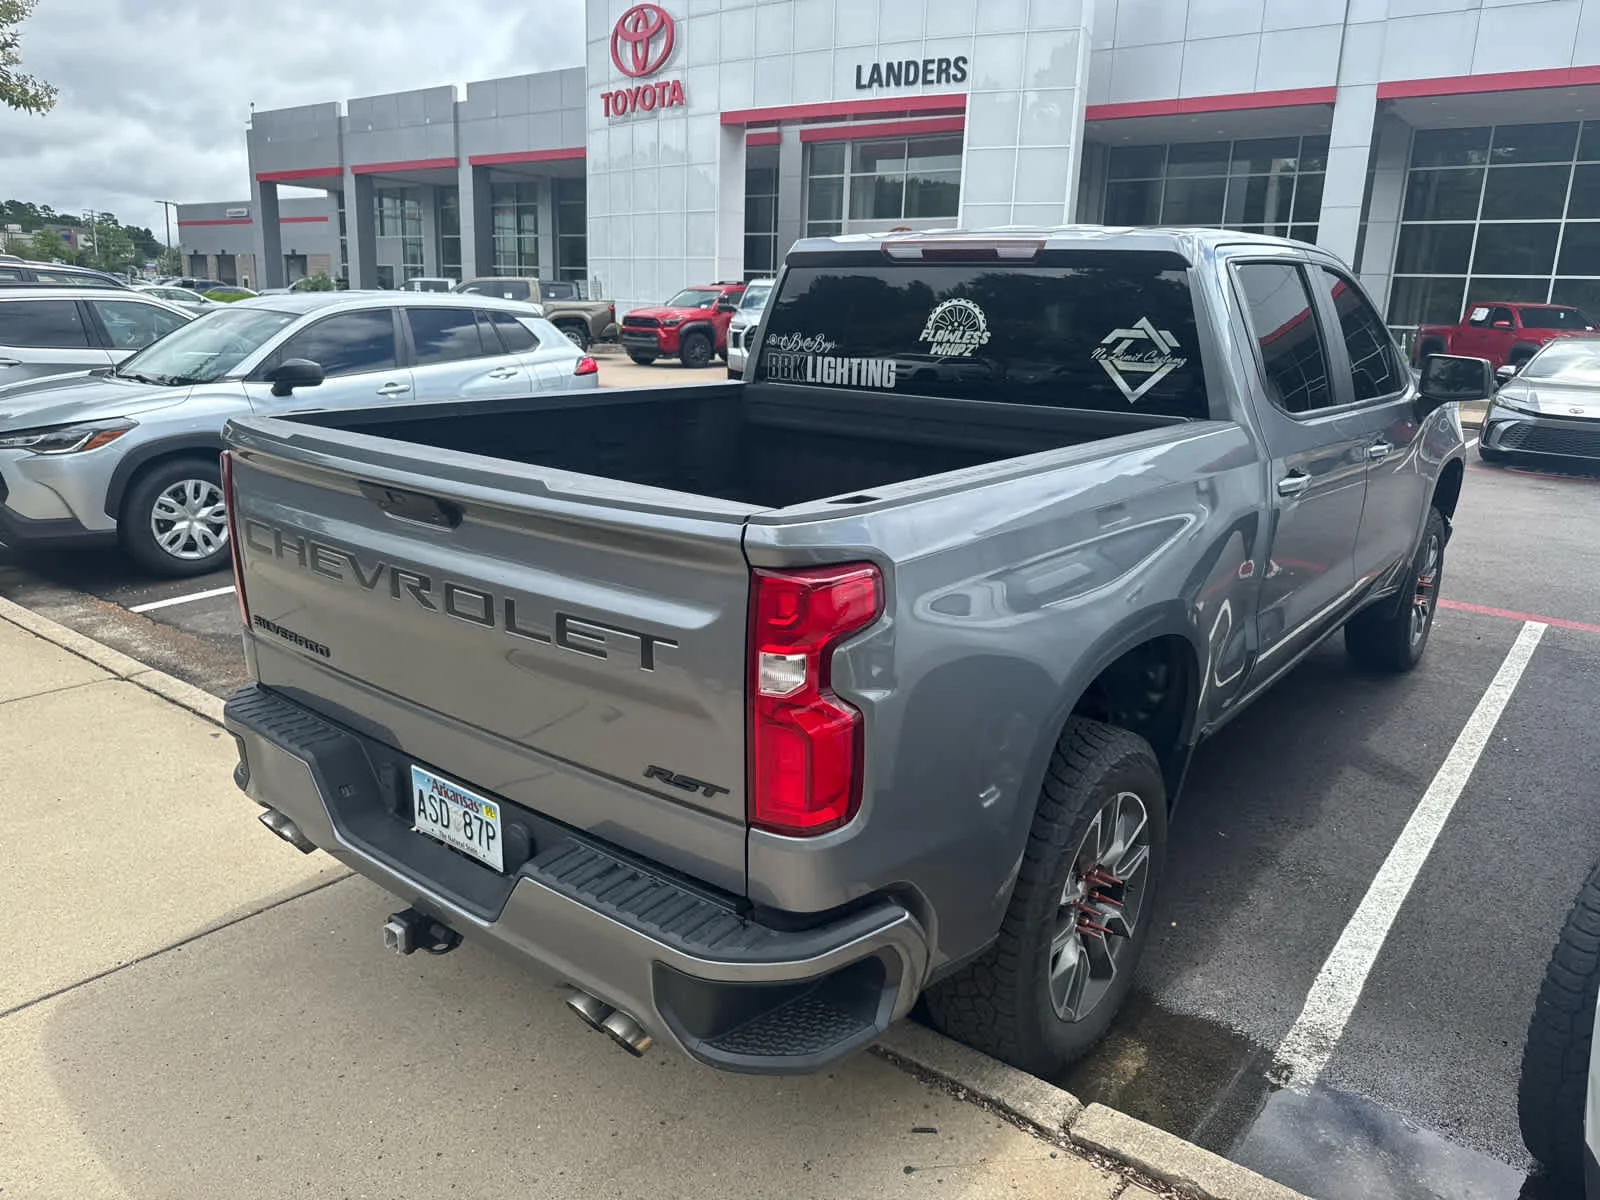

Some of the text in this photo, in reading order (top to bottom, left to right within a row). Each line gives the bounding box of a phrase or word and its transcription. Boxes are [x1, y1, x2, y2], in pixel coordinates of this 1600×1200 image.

[855, 55, 968, 90] LANDERS
[600, 79, 684, 117] TOYOTA
[918, 328, 991, 345] FLAWLESS
[245, 519, 680, 673] CHEVROLET
[253, 614, 331, 659] SILVERADO
[431, 778, 480, 813] Arkansas
[643, 764, 731, 798] RST
[417, 788, 496, 852] ASD 87P
